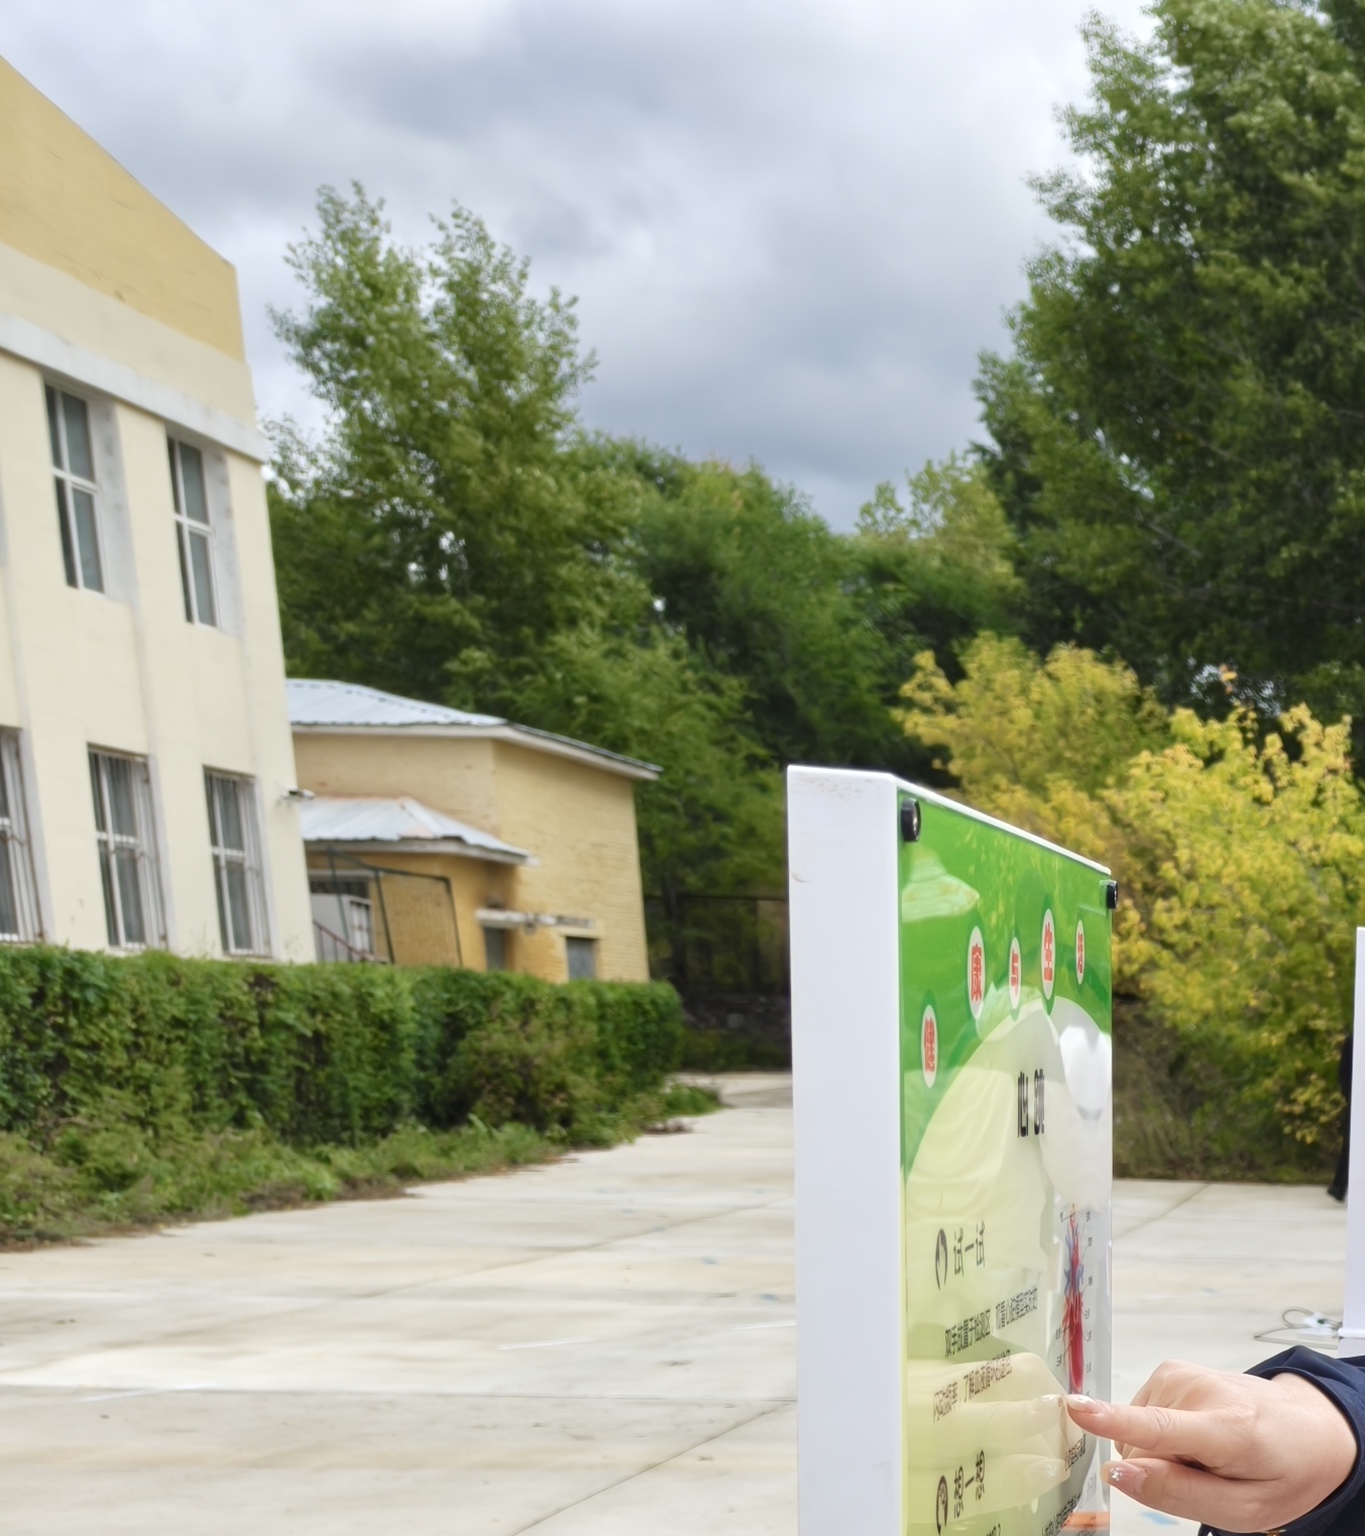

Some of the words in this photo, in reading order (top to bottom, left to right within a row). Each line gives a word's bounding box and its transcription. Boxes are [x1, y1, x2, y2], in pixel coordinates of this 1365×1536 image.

[953, 1220, 986, 1275] 试一试
[953, 1449, 986, 1520] 想一想
